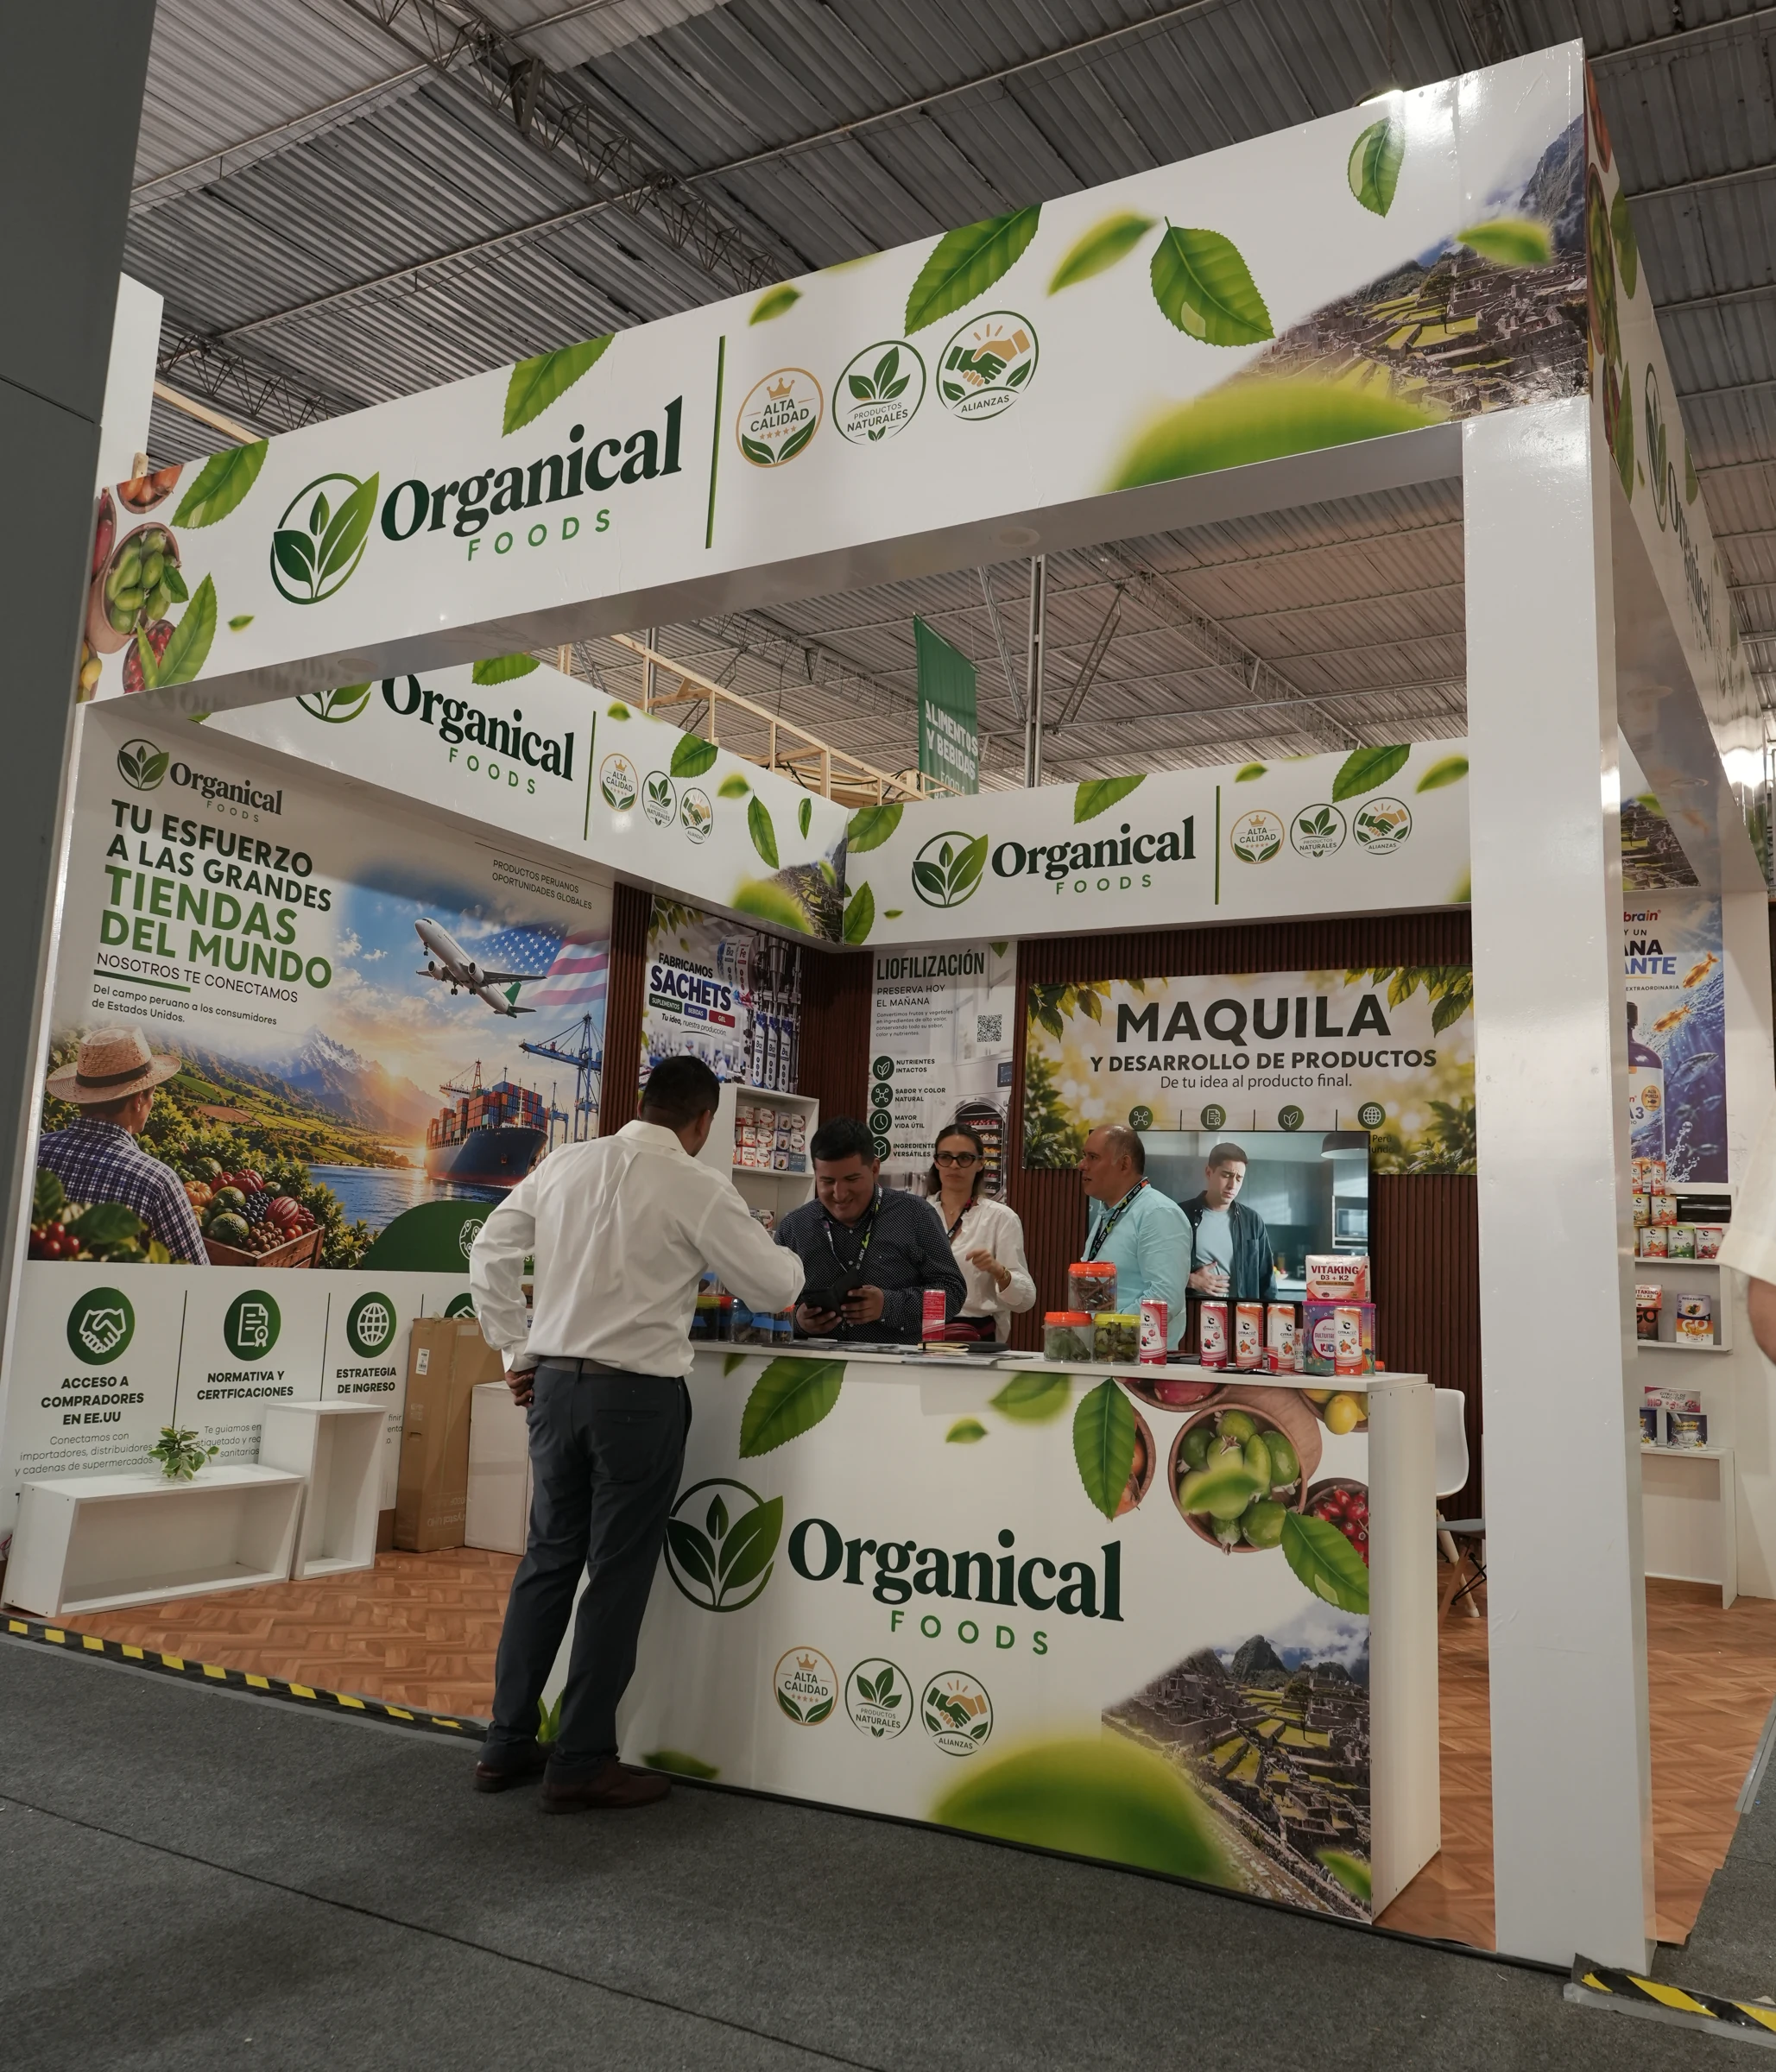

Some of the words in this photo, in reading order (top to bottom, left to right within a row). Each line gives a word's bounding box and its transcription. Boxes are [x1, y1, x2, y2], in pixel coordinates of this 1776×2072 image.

[763, 399, 795, 416] ALTA
[853, 401, 903, 420] PRODUCTOS
[960, 395, 1010, 414] ALIANZAS
[750, 408, 810, 433] CALIDAD
[847, 409, 908, 433] NATURALES
[381, 395, 682, 541] Organical
[467, 509, 610, 561] FOODS
[382, 673, 575, 781] Organical
[925, 699, 978, 757] ALIMENTOS
[926, 727, 935, 750] Y
[937, 736, 976, 780] BEBIDAS
[448, 747, 536, 795] FOODS
[612, 771, 627, 782] ALTA
[170, 761, 283, 816] Organical
[606, 776, 633, 793] CALIDAD
[206, 799, 260, 823] FOODS
[647, 807, 671, 822] NATURALES
[111, 799, 153, 834] TU
[161, 813, 313, 878] ESFUERZO
[687, 830, 704, 841] ALIANZAS
[1239, 833, 1276, 844] CALIDAD
[1247, 827, 1267, 836] ALTA
[991, 815, 1197, 881] Organical
[1299, 842, 1337, 851] NATURALES
[106, 833, 129, 862] A
[139, 840, 194, 877] LAS
[203, 858, 332, 913] GRANDES
[493, 859, 540, 881] PRODUCTOS
[540, 875, 579, 894] PERUANOS
[492, 872, 555, 898] OPORTUNIDADES
[556, 892, 592, 910] GLOBALES
[1056, 874, 1152, 895] FOODS
[104, 863, 298, 945] TIENDAS
[100, 909, 176, 958] DEL
[188, 928, 332, 989] MUNDO
[658, 952, 713, 979] FABRICAMOS
[876, 949, 985, 981] LIOFILIZACIÓN
[97, 952, 180, 981] NOSOTROS
[184, 970, 200, 984] TE
[205, 974, 298, 1003] CONECTAMOS
[650, 964, 732, 1012] SACHETS
[876, 985, 924, 995] PRESERVA
[926, 984, 945, 993] HOY
[92, 998, 104, 1009] de
[107, 1001, 148, 1017] Estados
[149, 1008, 186, 1023] Unidos.
[93, 983, 111, 995] Del
[112, 989, 147, 1003] campo
[149, 995, 190, 1010] peruano
[192, 1002, 198, 1011] a
[200, 1001, 213, 1014] los
[215, 1007, 277, 1026] consumidores
[652, 997, 680, 1011] SUPLEMENTOS
[876, 999, 888, 1008] EL
[889, 995, 930, 1008] MAÑANA
[661, 1013, 669, 1021] Tu
[669, 1015, 682, 1026] idea,
[682, 1020, 700, 1030] nuestra
[687, 1007, 704, 1018] BEBIDAS
[1116, 994, 1391, 1046] MAQUILA
[1090, 1056, 1104, 1072] Y
[1109, 1052, 1250, 1071] DESARROLLO
[1256, 1052, 1285, 1070] DE
[1292, 1049, 1438, 1069] PRODUCTOS
[1160, 1076, 1179, 1090] De
[1182, 1076, 1197, 1090] tu
[1199, 1074, 1229, 1089] idea
[1232, 1073, 1244, 1088] al
[1248, 1074, 1313, 1091] producto
[1318, 1072, 1353, 1088] final.
[1372, 1134, 1392, 1143] Perú
[1311, 1265, 1359, 1275] VITAKING
[61, 1376, 117, 1389] ACCESO
[120, 1375, 130, 1387] A
[207, 1371, 275, 1383] NORMATIVA
[277, 1370, 285, 1380] Y
[336, 1367, 397, 1379] ESTRATEGIA
[197, 1386, 294, 1400] CERTFICACIONES
[337, 1383, 351, 1393] DE
[352, 1381, 395, 1393] INGRESO
[41, 1393, 144, 1408] COMPRADORES
[62, 1412, 81, 1425] EN
[84, 1411, 122, 1424] EE.UU
[50, 1433, 110, 1445] Conectamos
[113, 1431, 130, 1441] con
[205, 1425, 213, 1434] Te
[215, 1424, 250, 1435] guiamos
[20, 1448, 88, 1462] importadores,
[91, 1443, 153, 1456] distribuidores
[220, 1448, 260, 1458] sanitarios
[15, 1468, 21, 1476] y
[22, 1463, 66, 1475] cadenas
[68, 1461, 80, 1471] de
[83, 1456, 155, 1472] supermercados.
[787, 1518, 1124, 1622] Organical
[891, 1609, 1048, 1656] FOODS
[793, 1671, 818, 1684] ALTA
[784, 1680, 828, 1696] CALIDAD
[856, 1714, 901, 1728] NATURALES
[860, 1708, 896, 1720] PRODUCTOS
[939, 1737, 973, 1750] ALIANZAS
